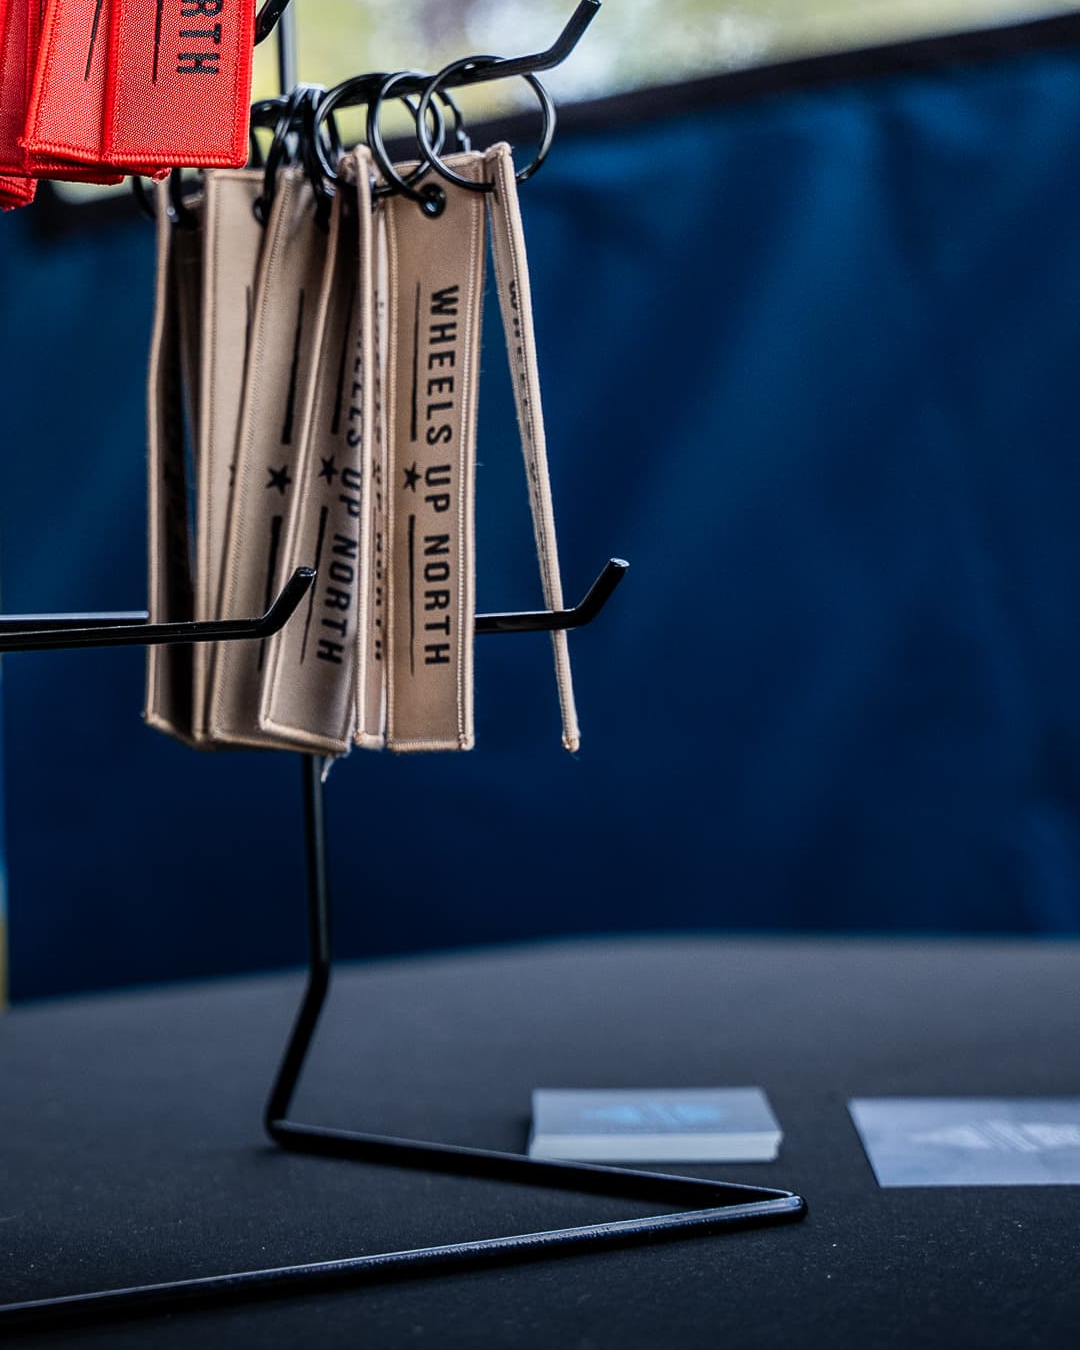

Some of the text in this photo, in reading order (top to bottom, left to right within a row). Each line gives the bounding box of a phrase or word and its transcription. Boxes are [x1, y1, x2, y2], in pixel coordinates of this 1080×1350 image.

[339, 467, 360, 517] UP
[424, 285, 459, 664] WHEELS UP NORTH
[316, 535, 357, 665] NORTH
